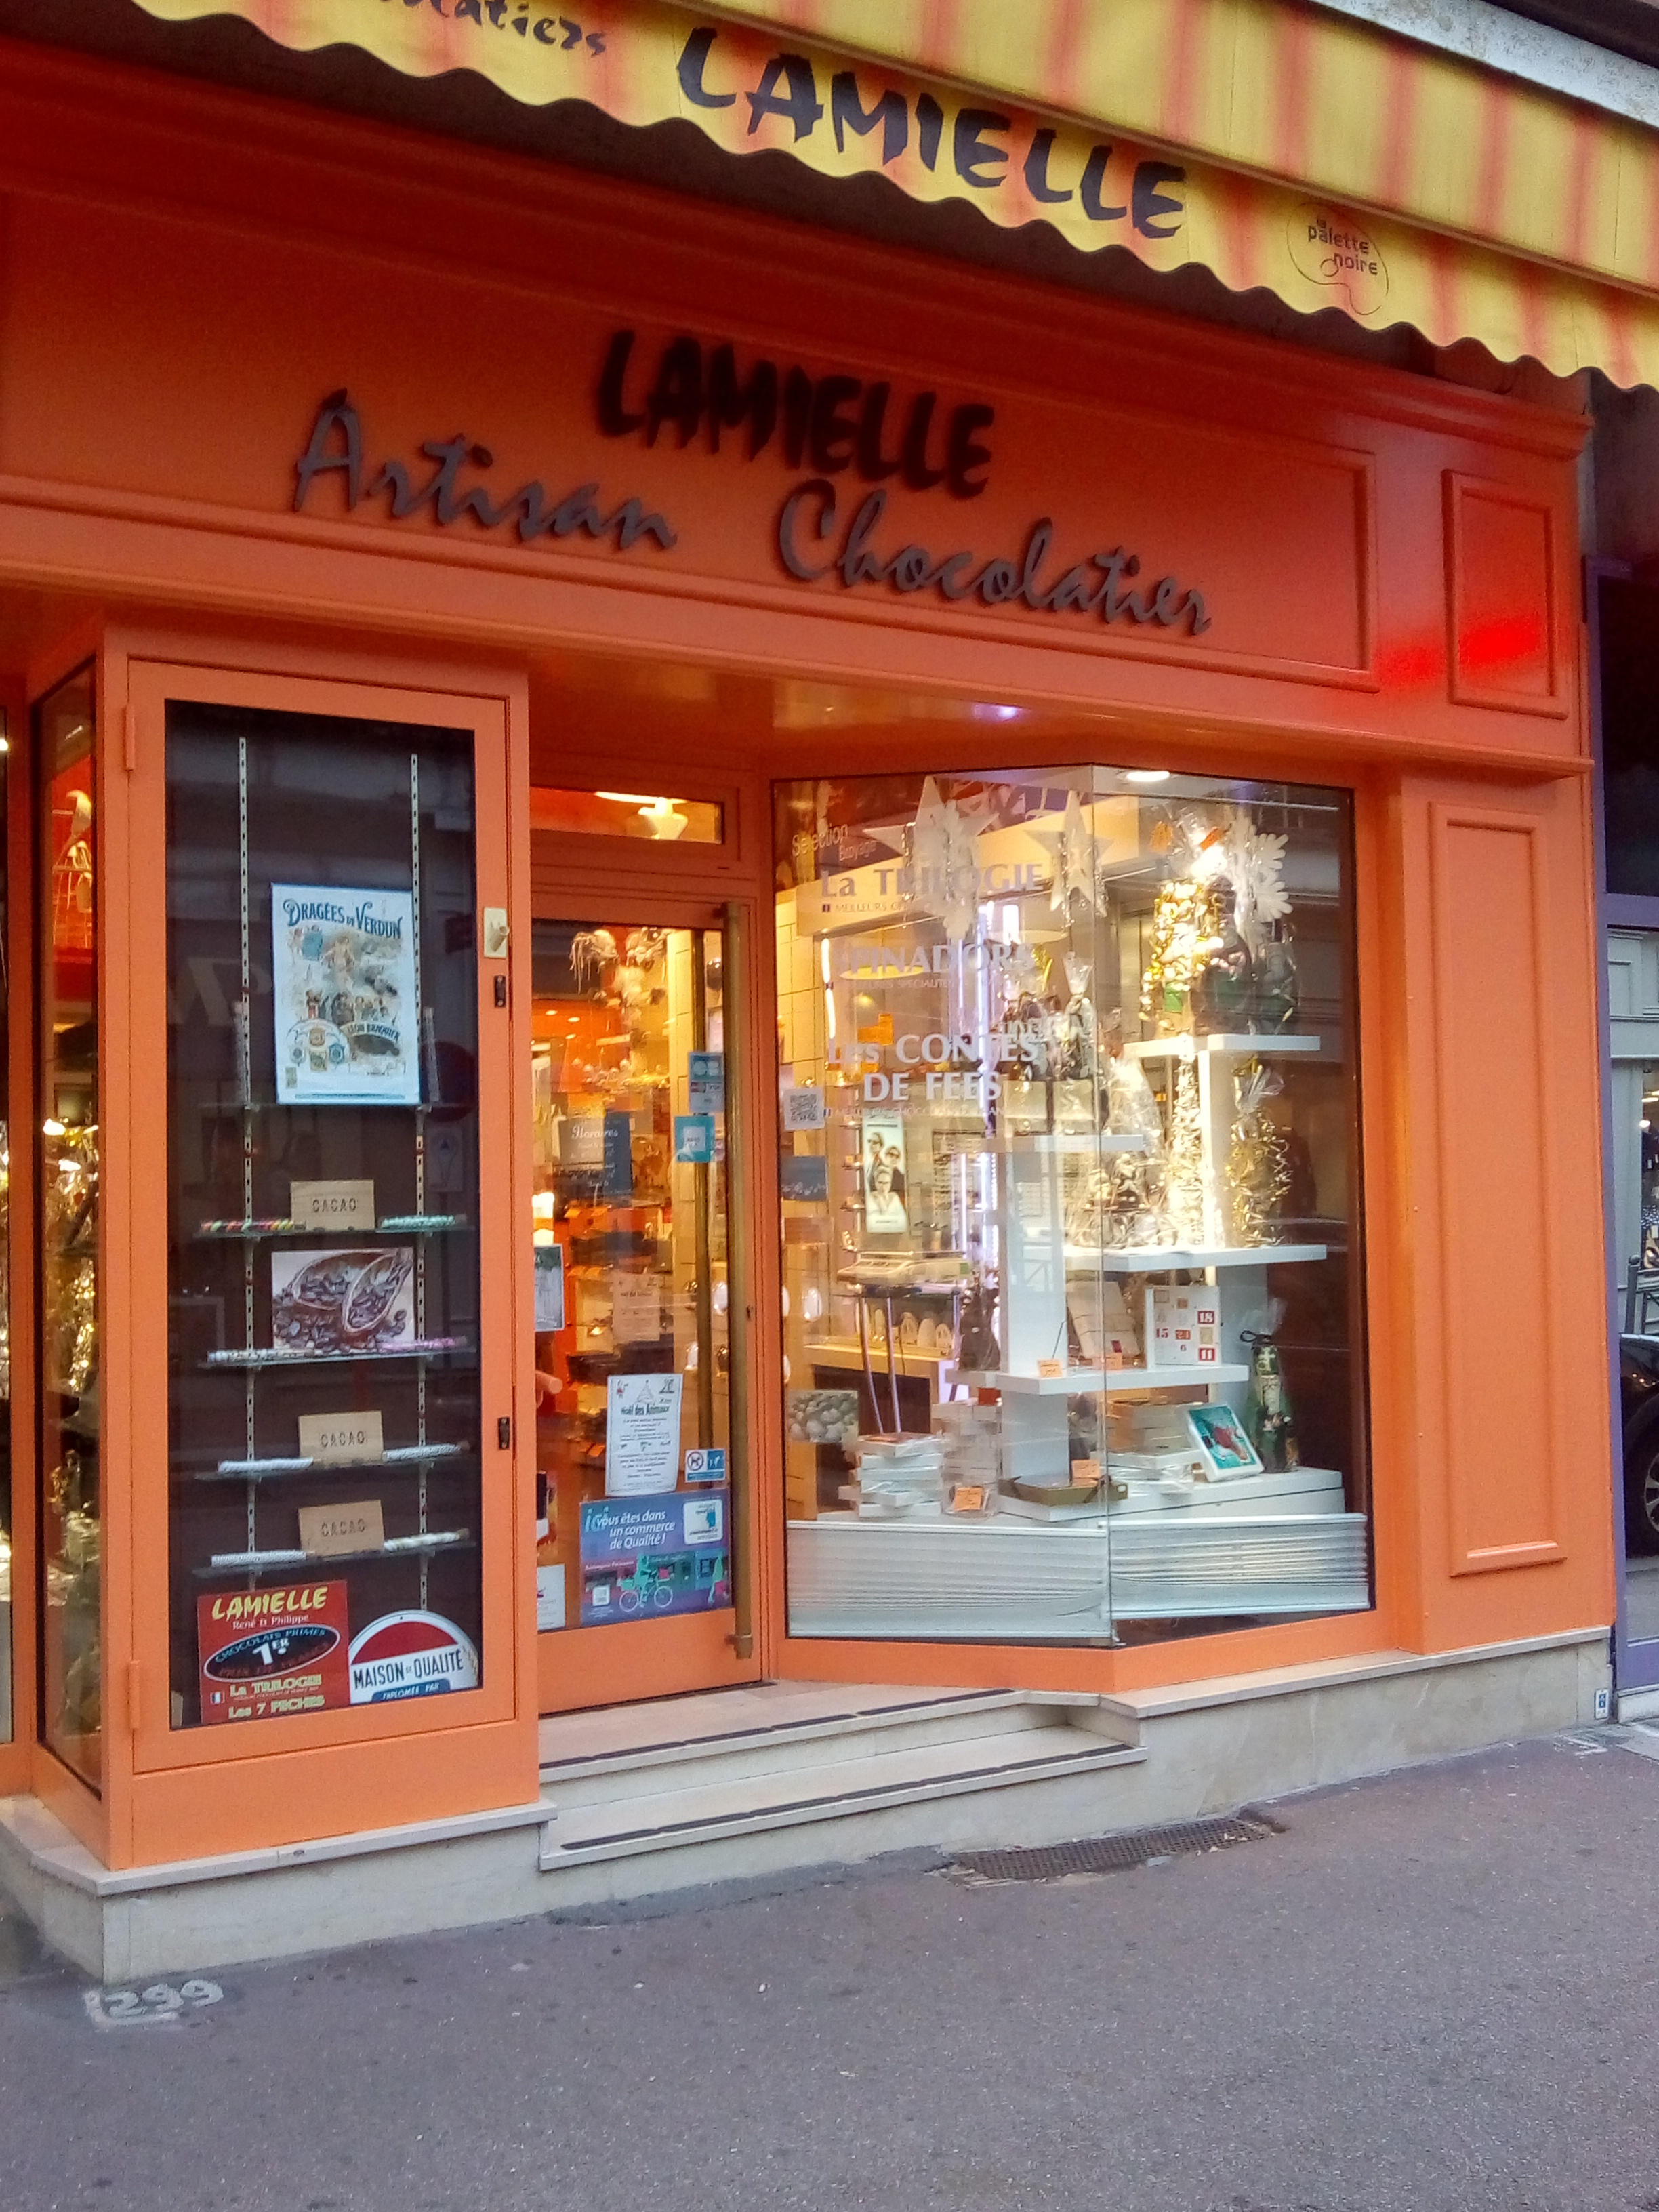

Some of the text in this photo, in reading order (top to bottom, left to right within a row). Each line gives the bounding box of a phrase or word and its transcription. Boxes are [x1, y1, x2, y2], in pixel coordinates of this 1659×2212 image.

[677, 27, 1185, 239] LAMIELLE
[1307, 225, 1369, 255] palette
[1333, 252, 1378, 276] noire
[597, 329, 995, 500] LAMIELLE
[292, 387, 1211, 636] Artisan Chocolatier
[821, 869, 856, 898] La
[356, 901, 403, 939] VERDUN
[896, 1033, 1040, 1065] CONTES
[863, 1072, 909, 1102] DE
[312, 1197, 356, 1213] CACAO
[1199, 1312, 1214, 1323] 18
[1156, 1328, 1169, 1338] 15
[1201, 1349, 1213, 1360] 11
[321, 1431, 366, 1449] CACAO
[321, 1518, 366, 1537] CACAO
[596, 1509, 666, 1526] vous êtes dans
[609, 1528, 623, 1538] un
[625, 1521, 676, 1536] commerce
[609, 1538, 622, 1551] de
[211, 1586, 328, 1622] LAMIELLE
[353, 1661, 405, 1690] MAISON
[230, 1685, 247, 1698] La
[256, 1702, 267, 1716] 7
[104, 1979, 225, 2018] 299
